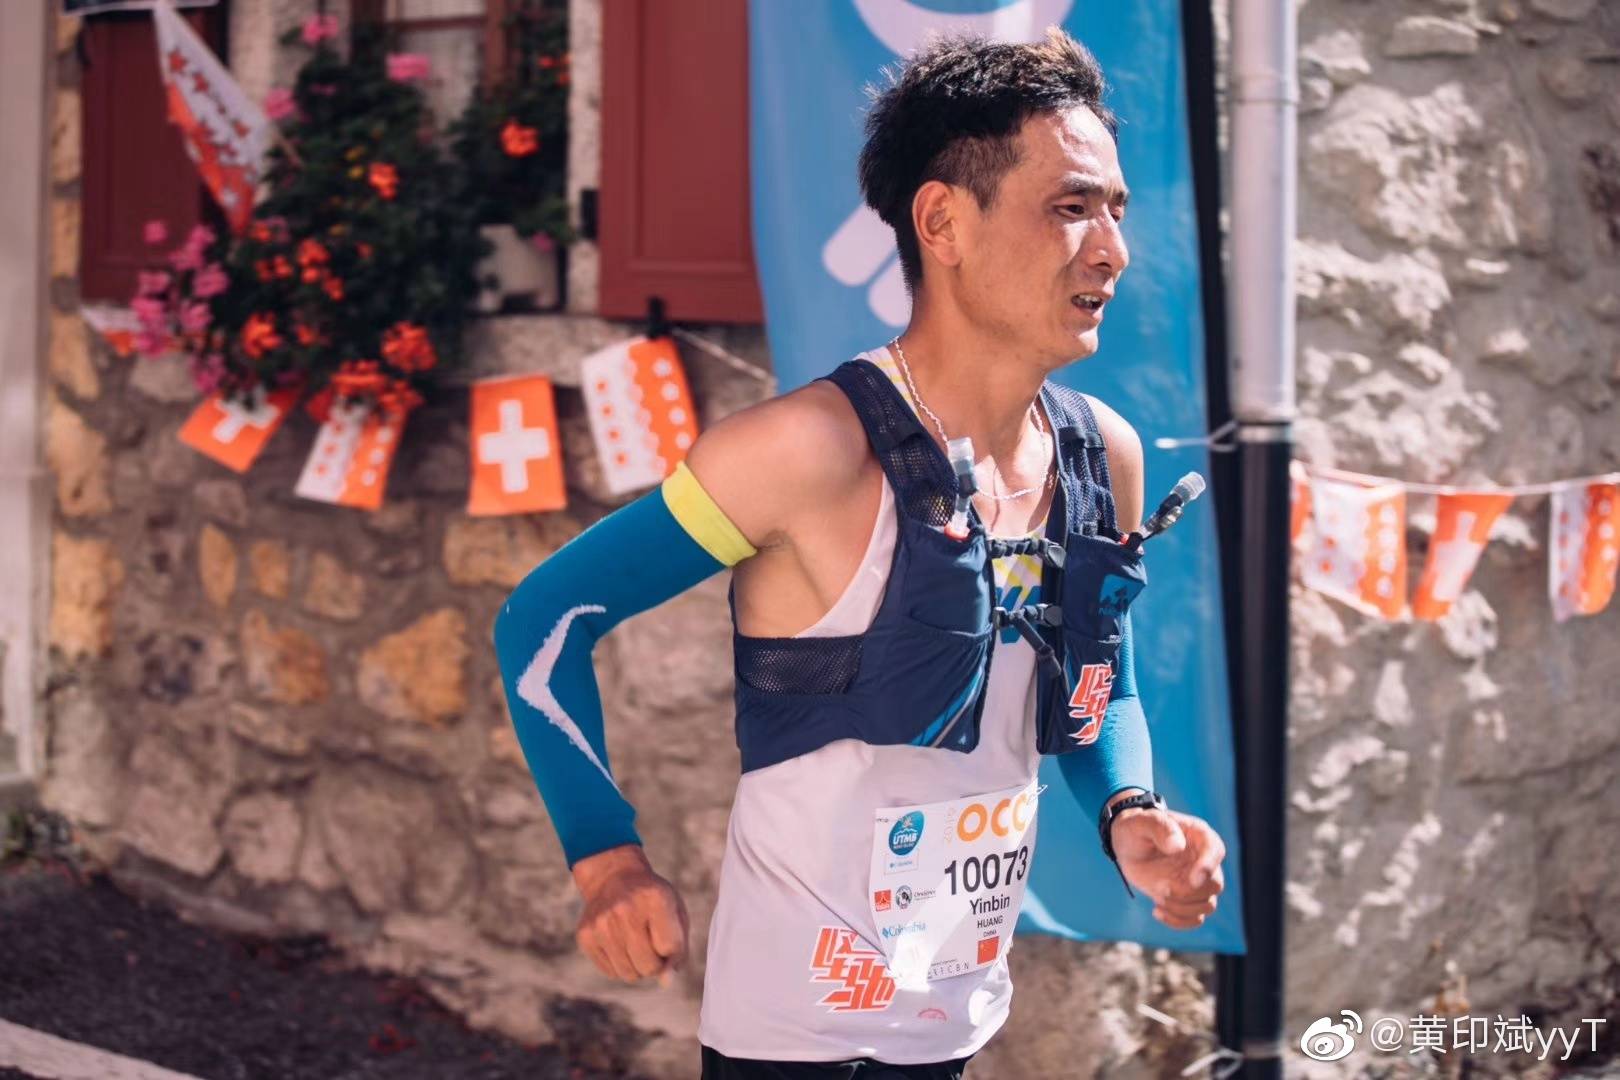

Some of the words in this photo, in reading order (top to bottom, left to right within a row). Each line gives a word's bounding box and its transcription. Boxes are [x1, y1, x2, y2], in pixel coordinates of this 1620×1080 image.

[957, 793, 1029, 842] OCC
[893, 831, 917, 845] UTMB
[945, 846, 1028, 895] 10073
[970, 894, 1010, 915] Yinbin
[889, 922, 926, 937] Colbia
[977, 915, 1003, 928] HUANG
